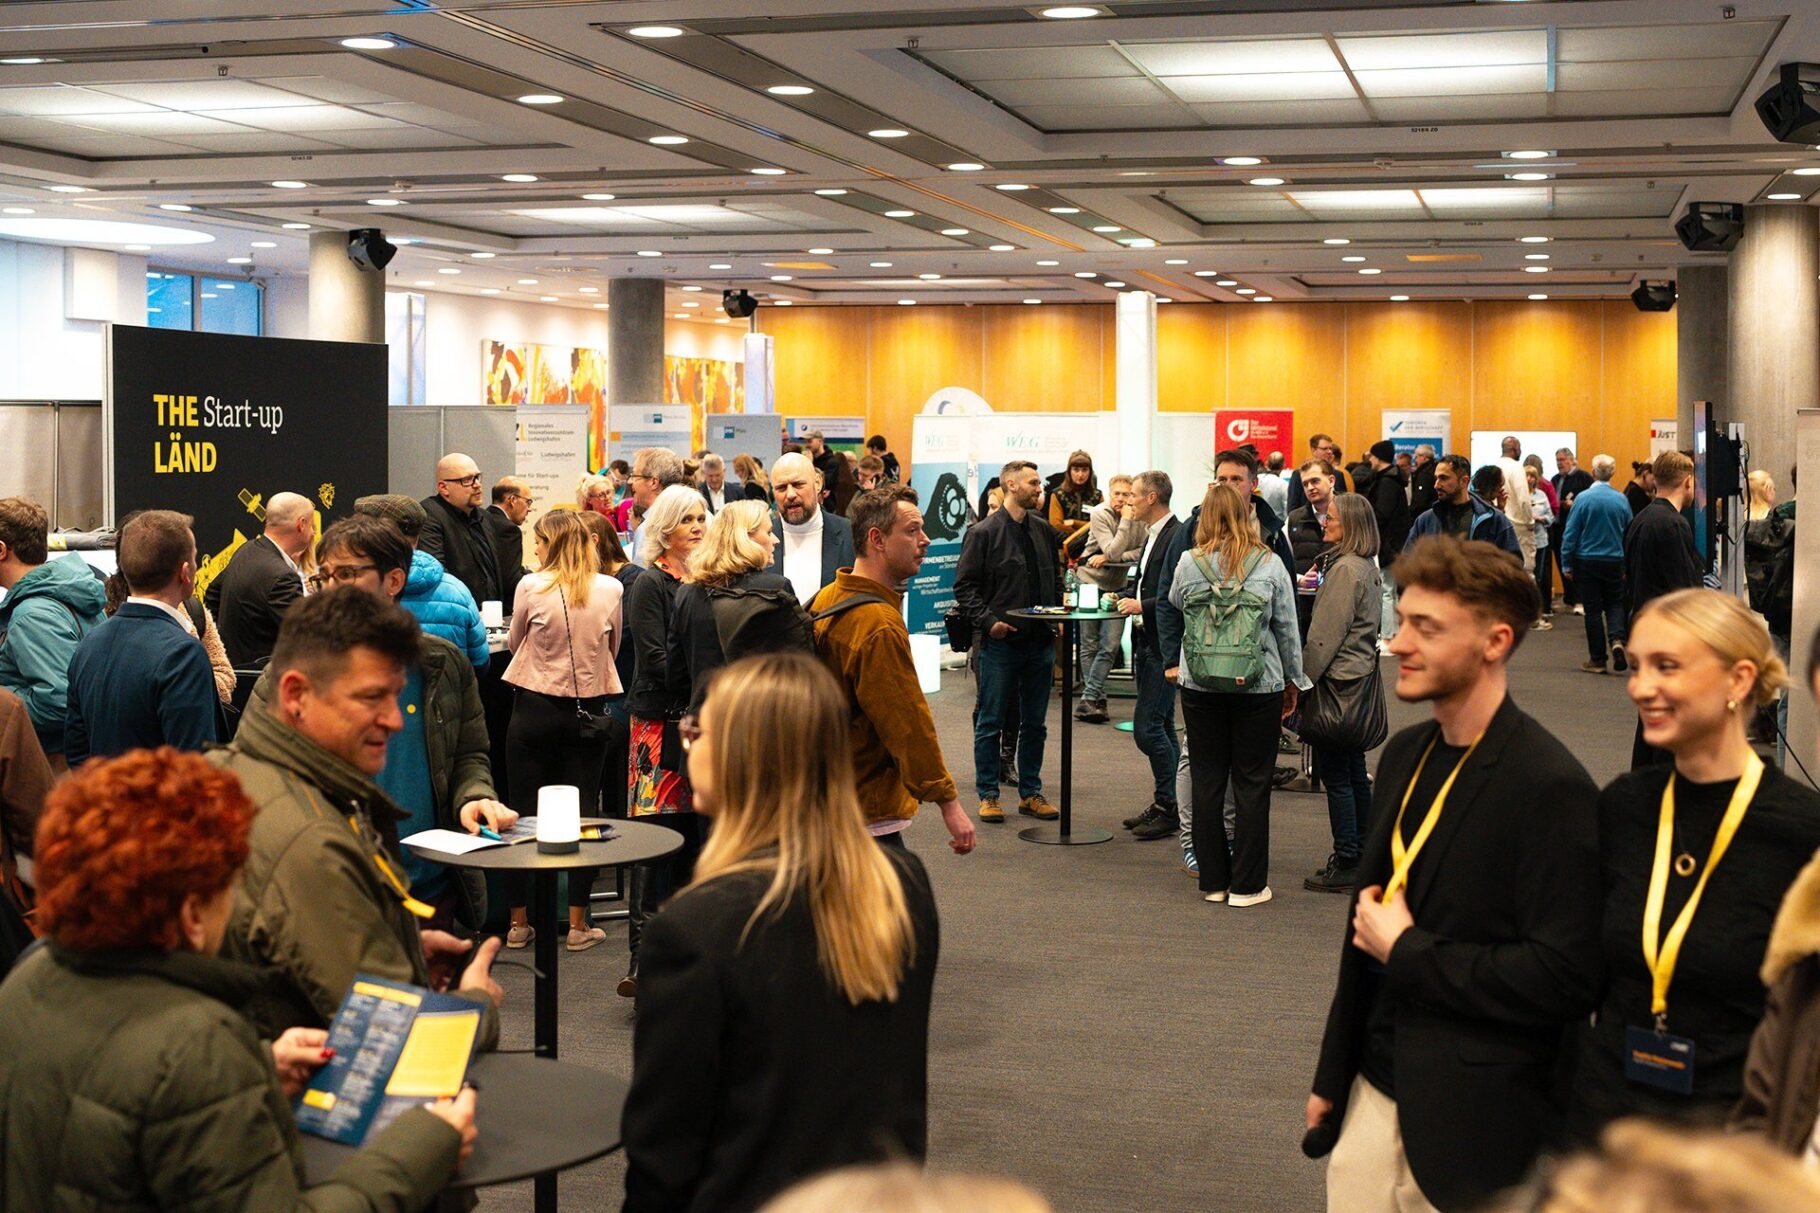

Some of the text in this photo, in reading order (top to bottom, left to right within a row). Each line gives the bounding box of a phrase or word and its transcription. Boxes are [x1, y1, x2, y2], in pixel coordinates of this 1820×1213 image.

[153, 394, 283, 434] THE Start-up
[155, 432, 217, 473] LÄND
